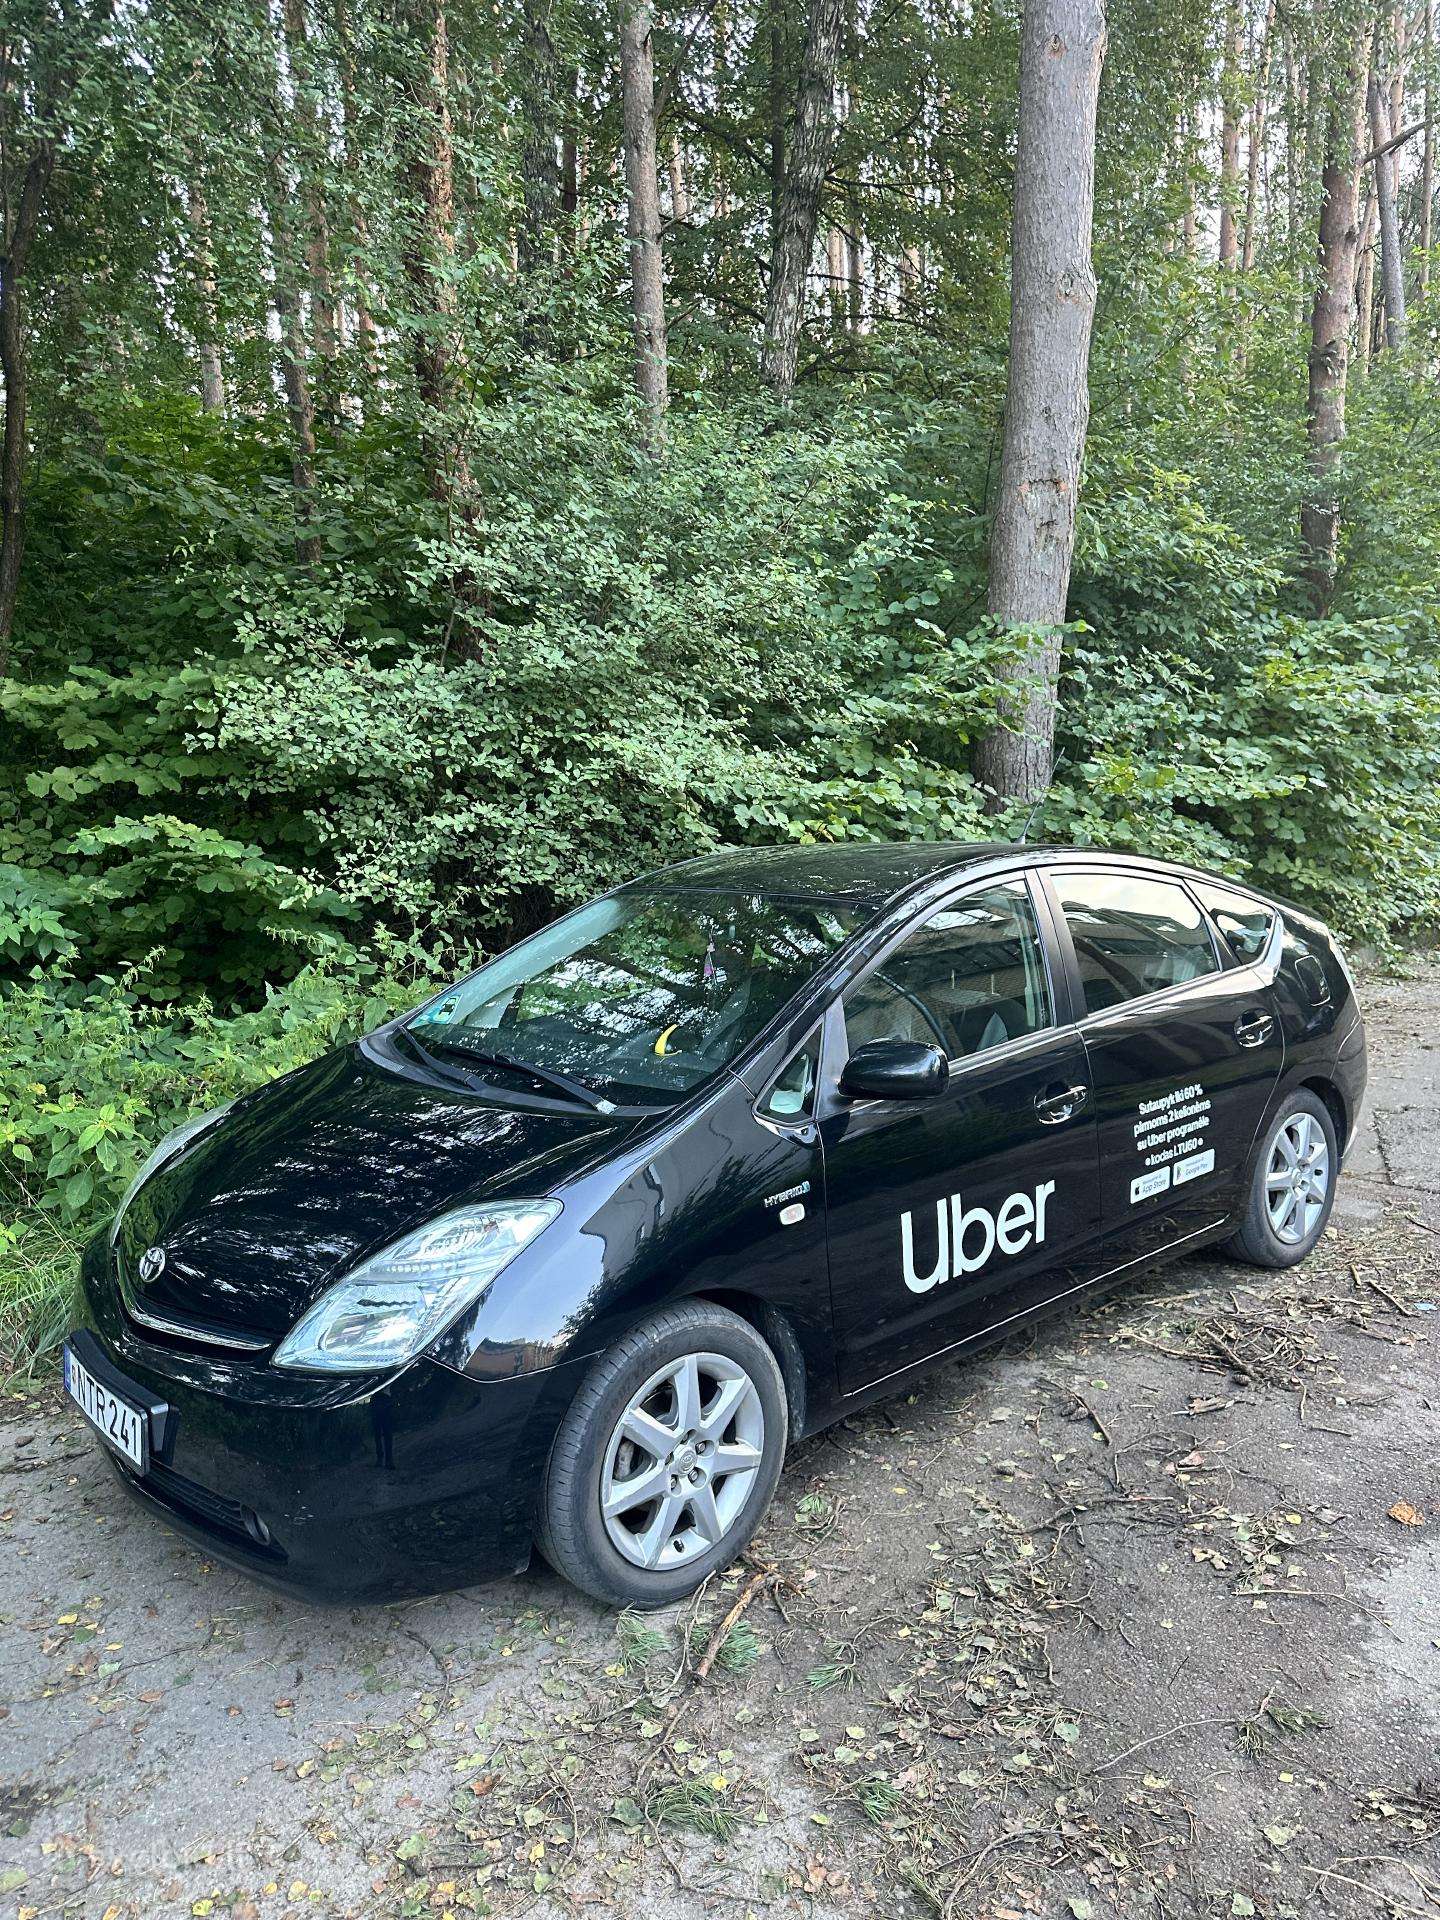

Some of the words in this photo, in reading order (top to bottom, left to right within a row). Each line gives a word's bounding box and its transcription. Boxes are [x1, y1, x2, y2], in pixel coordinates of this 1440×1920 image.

[1139, 1093, 1176, 1115] Sutaupyk
[1184, 1085, 1195, 1100] 60
[1194, 1083, 1204, 1096] %
[1133, 1115, 1169, 1138] pirmoms
[1167, 1110, 1175, 1123] 2
[1136, 1138, 1148, 1151] su
[1146, 1131, 1167, 1148] Uber
[1150, 1149, 1174, 1166] kodas
[1173, 1140, 1198, 1157] LTU60
[763, 1185, 803, 1208] HYBRID
[901, 1179, 1055, 1294] Uber
